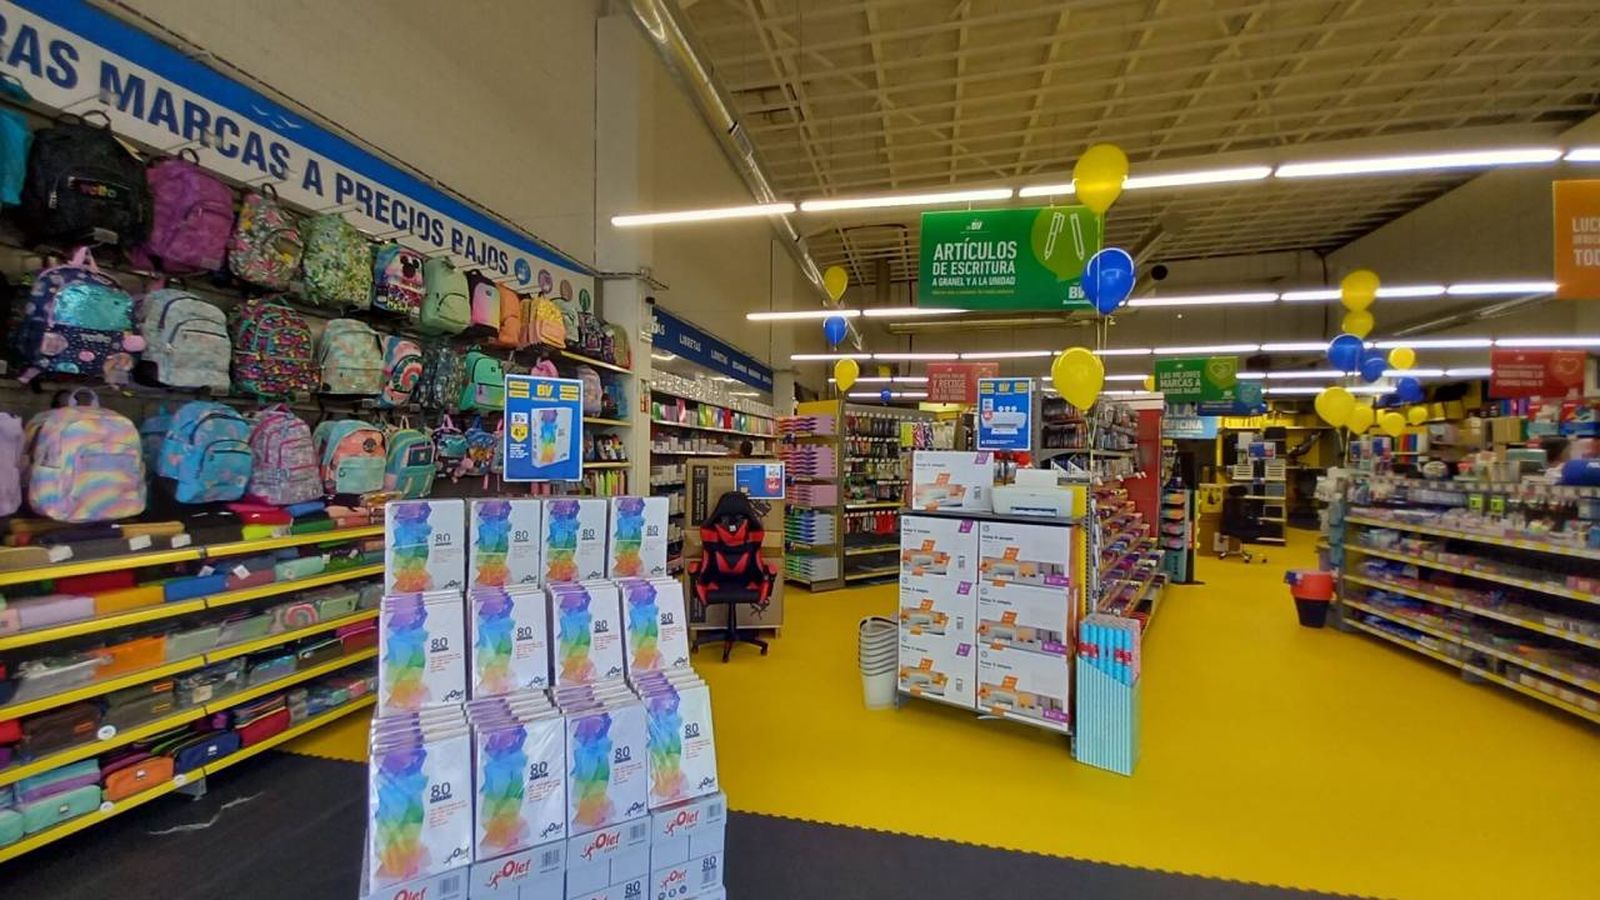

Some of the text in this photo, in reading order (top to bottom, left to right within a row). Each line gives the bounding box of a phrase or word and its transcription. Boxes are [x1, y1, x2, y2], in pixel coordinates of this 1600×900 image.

[0, 14, 509, 275] AS MARCAS A PRECIOS BAJOS
[933, 237, 1018, 261] ARTÍCULOS
[932, 260, 1016, 276] DE ESCRITURA
[932, 276, 1016, 287] A GRANEL Y A LA UNIDAD
[514, 530, 529, 540] 80
[582, 528, 595, 538] 80
[660, 612, 673, 623] 80
[516, 626, 532, 637] 80
[594, 620, 608, 630] 80
[431, 637, 448, 649] 80
[685, 722, 699, 736] 80
[615, 745, 630, 760] 80
[530, 761, 548, 775] 80
[431, 782, 451, 798] 80
[703, 855, 717, 869] 80
[625, 880, 641, 895] 80
